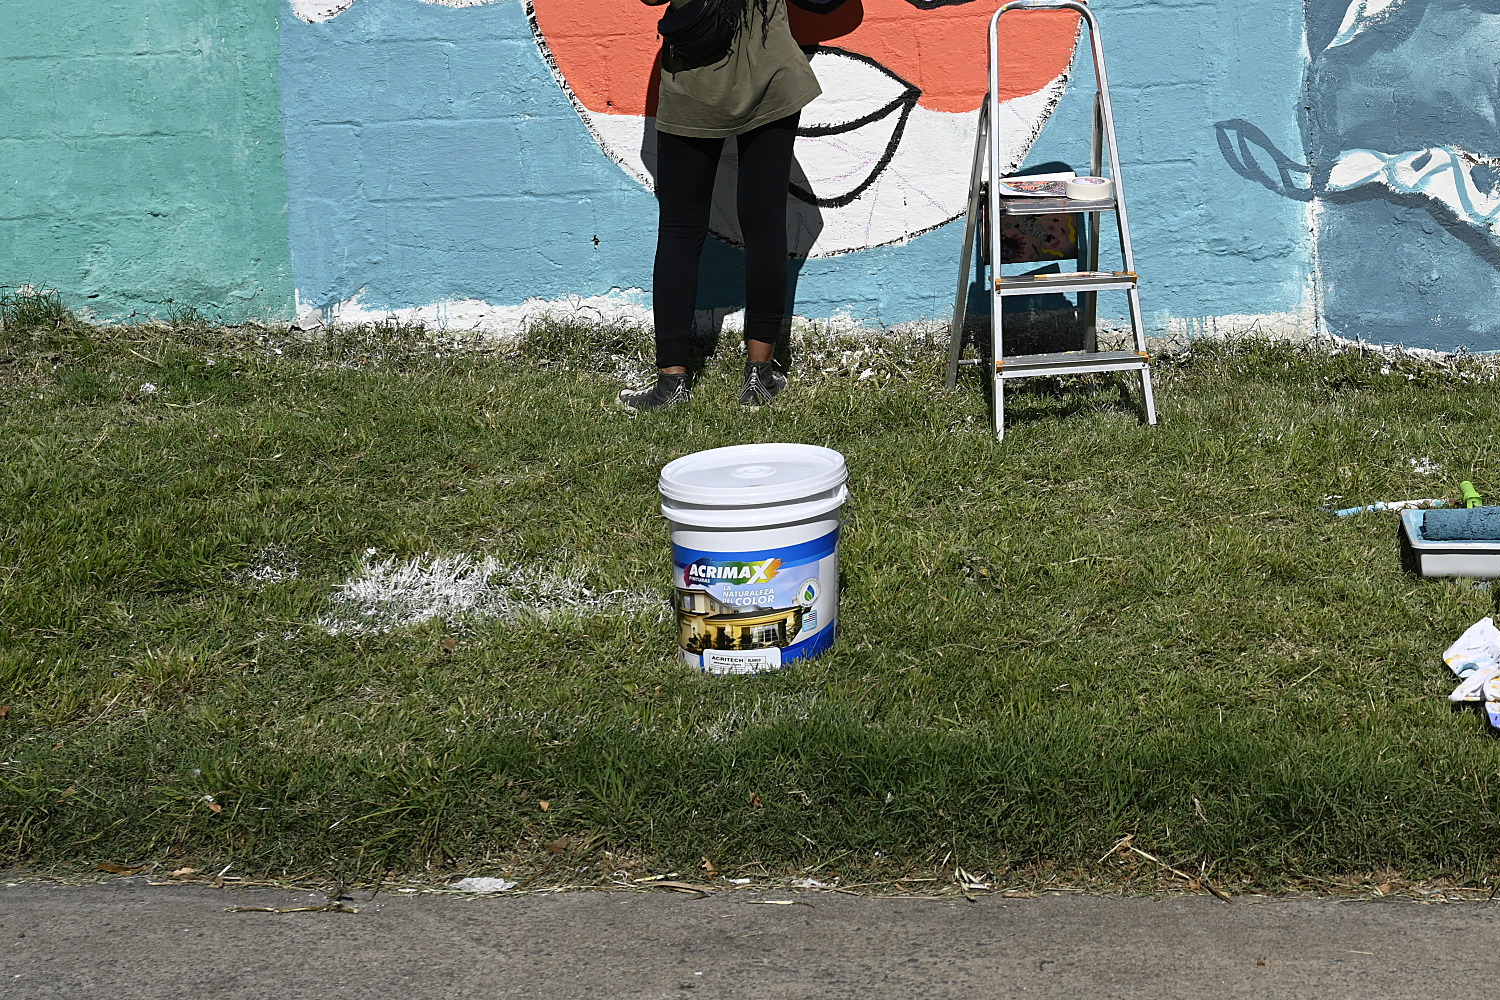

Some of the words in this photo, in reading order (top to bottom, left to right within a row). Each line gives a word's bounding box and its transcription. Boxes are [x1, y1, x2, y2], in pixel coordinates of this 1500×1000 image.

[689, 558, 775, 584] ACRIMAX
[688, 576, 711, 584] PINTURAS
[722, 588, 775, 597] NATURALEZA
[735, 595, 775, 606] COLOR
